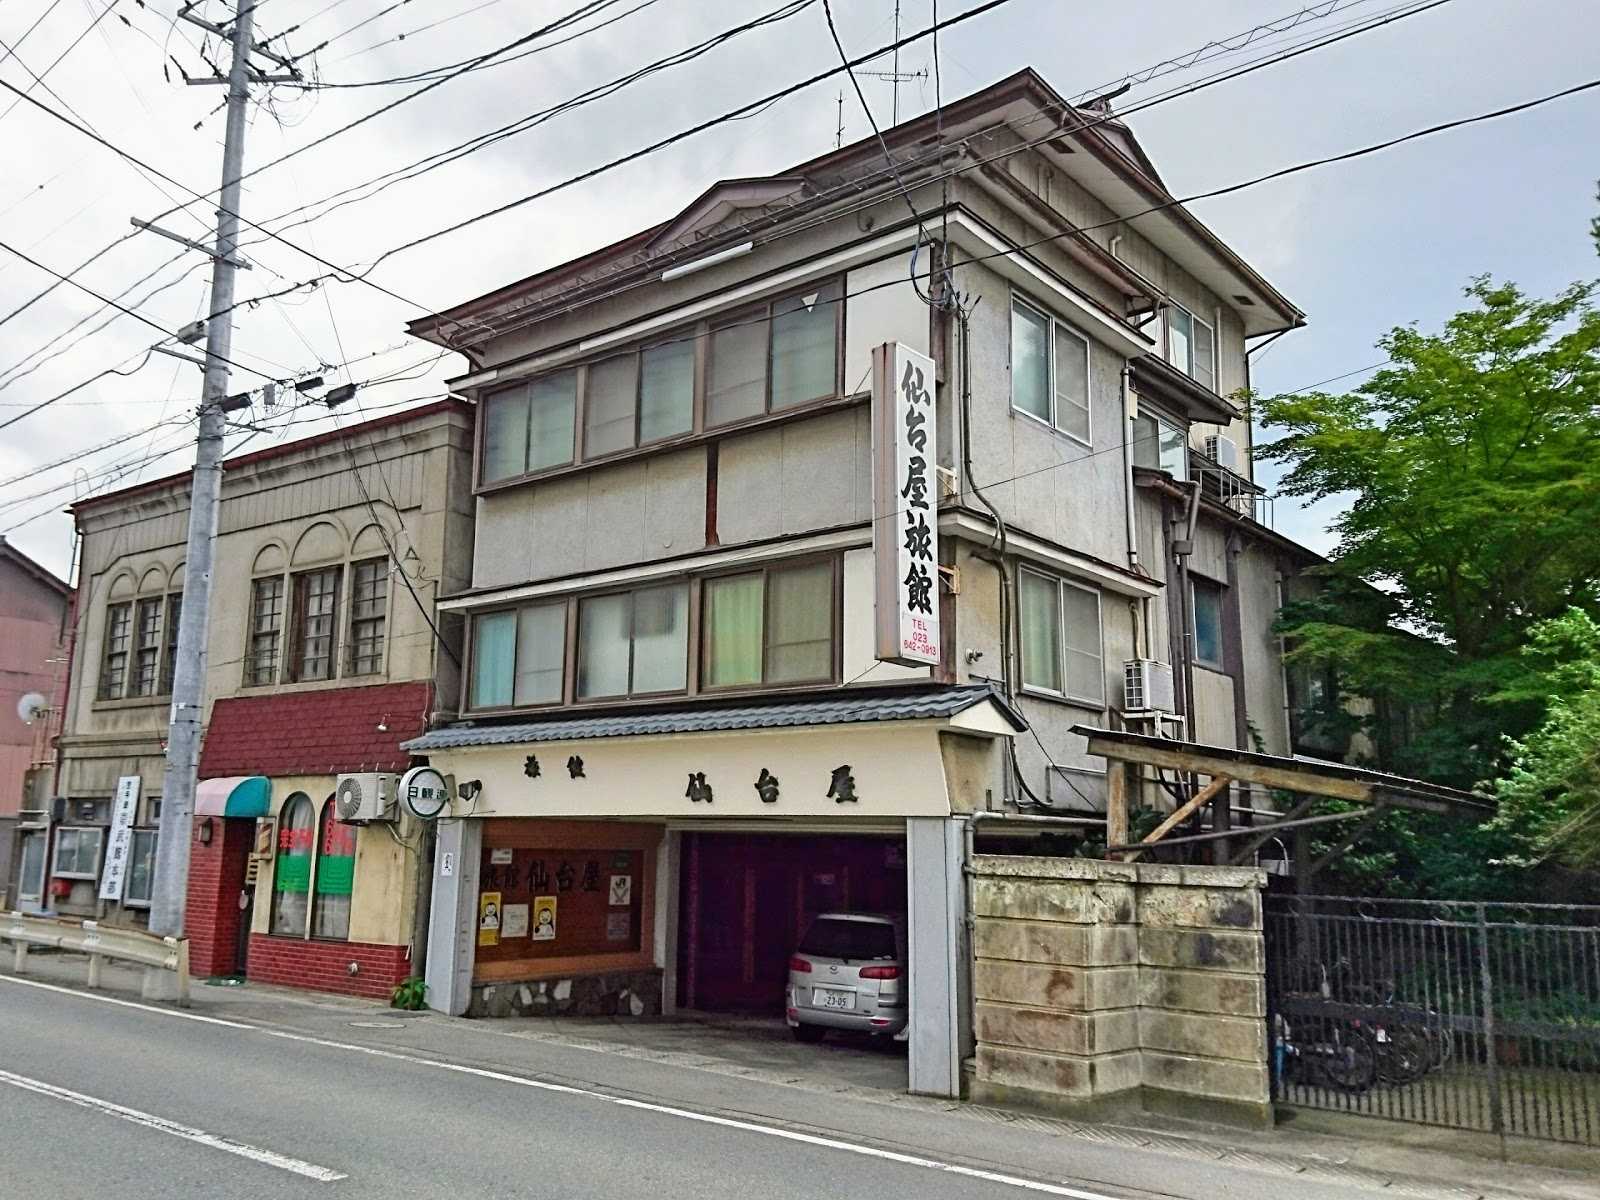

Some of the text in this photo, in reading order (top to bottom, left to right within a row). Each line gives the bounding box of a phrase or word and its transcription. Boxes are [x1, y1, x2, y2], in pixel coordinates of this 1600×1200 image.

[902, 361, 933, 616] 仙台屋旅館
[911, 618, 928, 631] TEL
[912, 631, 928, 644] 023
[686, 764, 860, 804] 仙台屋
